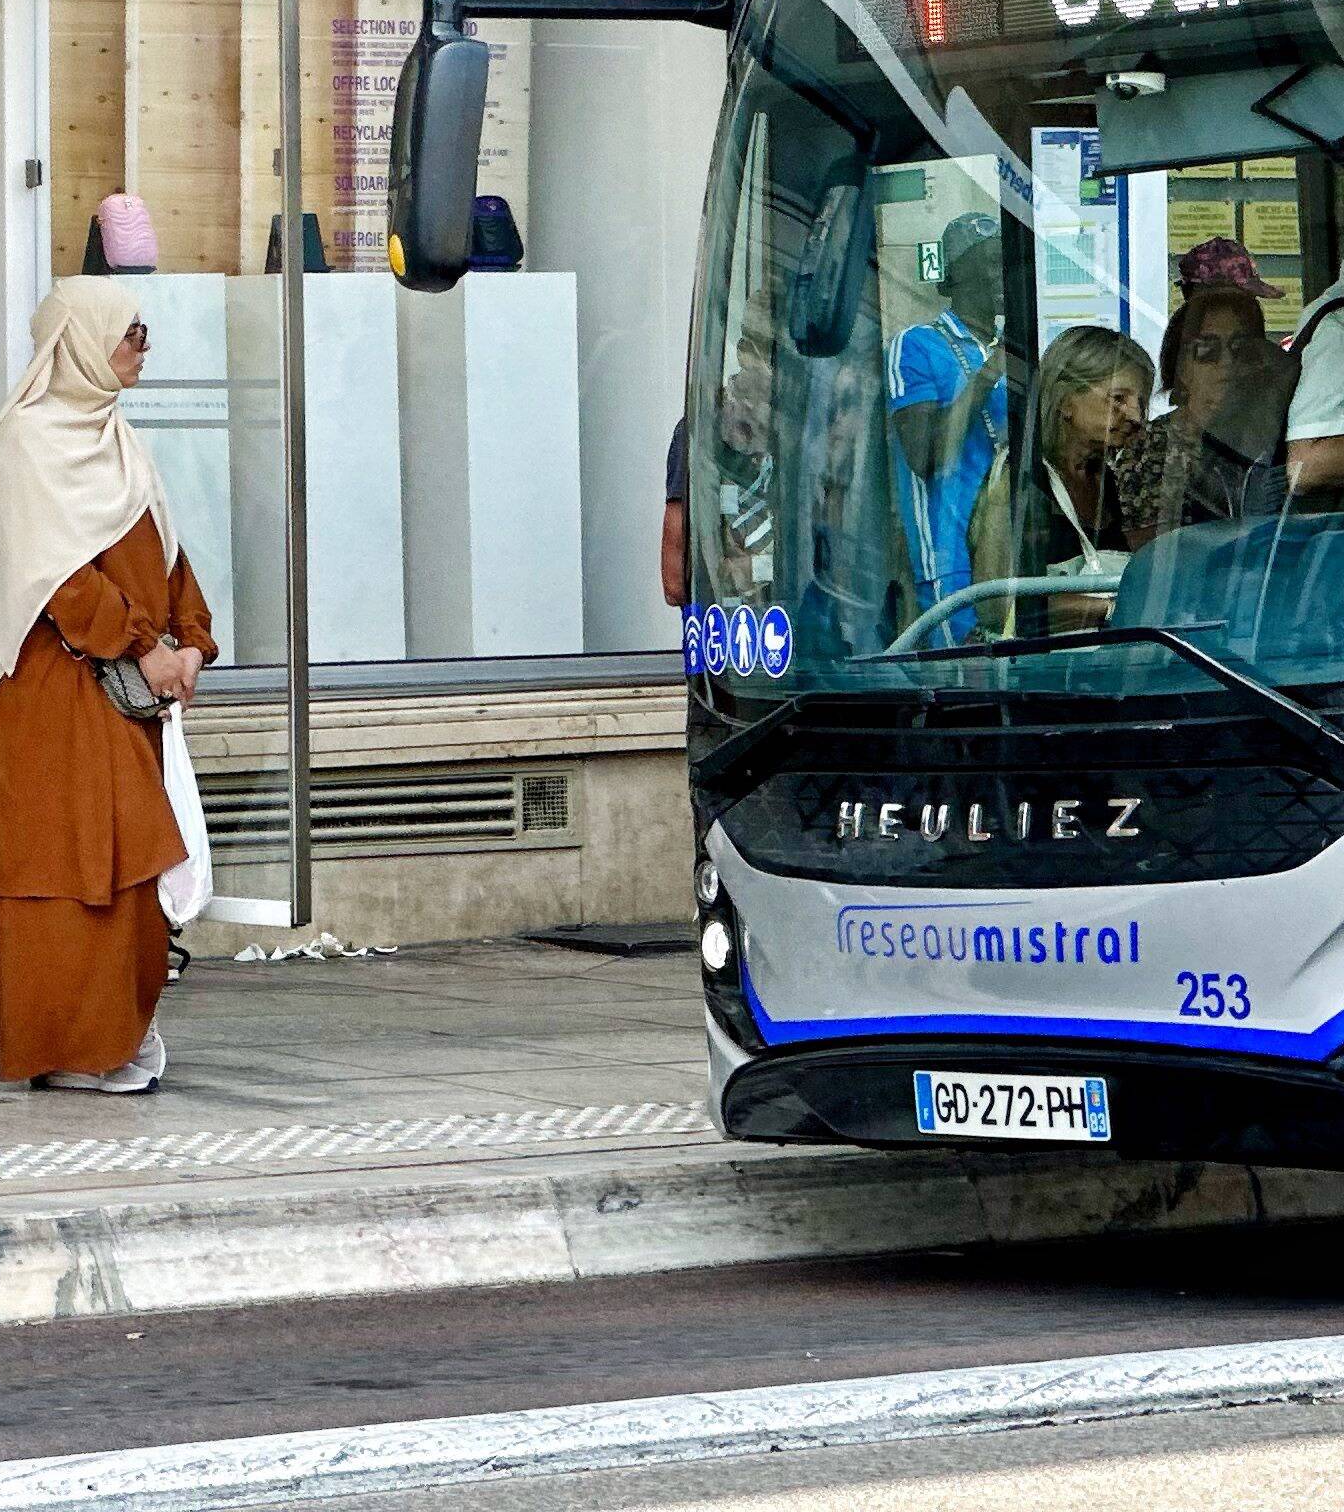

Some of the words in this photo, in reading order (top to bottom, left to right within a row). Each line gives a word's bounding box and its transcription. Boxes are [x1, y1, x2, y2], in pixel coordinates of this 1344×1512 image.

[332, 19, 395, 36] SELECTION
[333, 75, 370, 91] OFFRE
[333, 124, 392, 142] RECYCLAG
[334, 231, 384, 247] ENERGIE
[836, 798, 1142, 842] HEULIEZ
[1176, 971, 1251, 1020] 253
[935, 1082, 1088, 1129] GD-272-PH
[1090, 1112, 1106, 1133] 83
